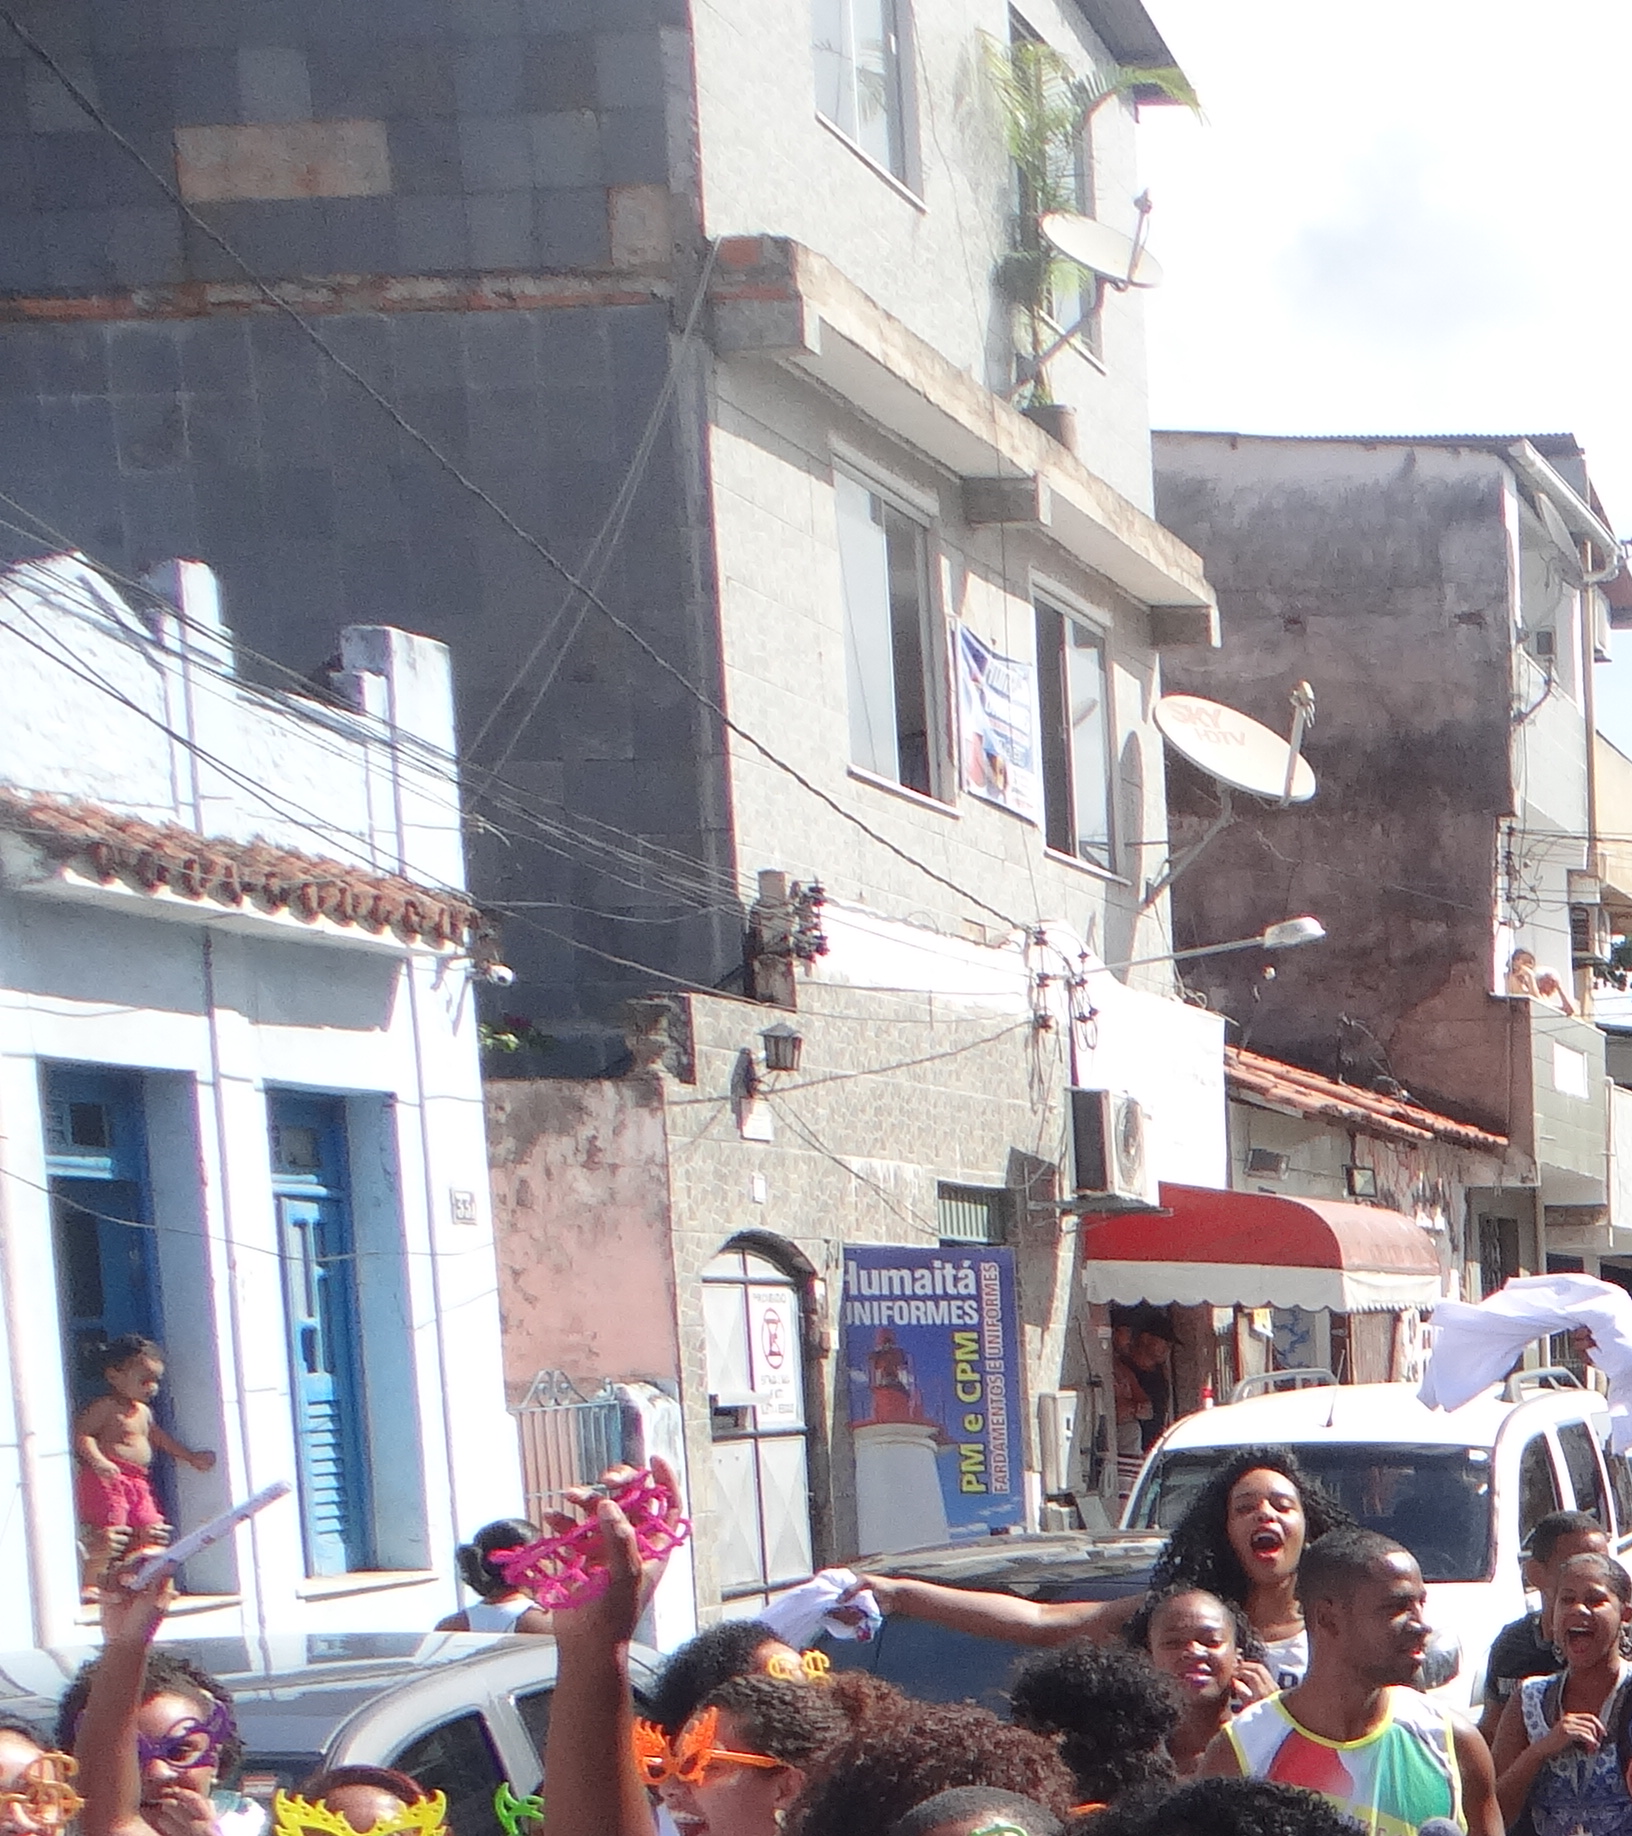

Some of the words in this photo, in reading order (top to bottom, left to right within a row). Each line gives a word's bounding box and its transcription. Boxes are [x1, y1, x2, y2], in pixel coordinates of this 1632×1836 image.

[1165, 702, 1222, 729] SKY
[982, 1262, 1004, 1358] UNIFORMES
[954, 1330, 983, 1405] CPM
[987, 1360, 1004, 1373] E
[963, 1413, 984, 1434] e
[988, 1374, 1010, 1494] FARDAMENTOS
[960, 1443, 988, 1494] PM
